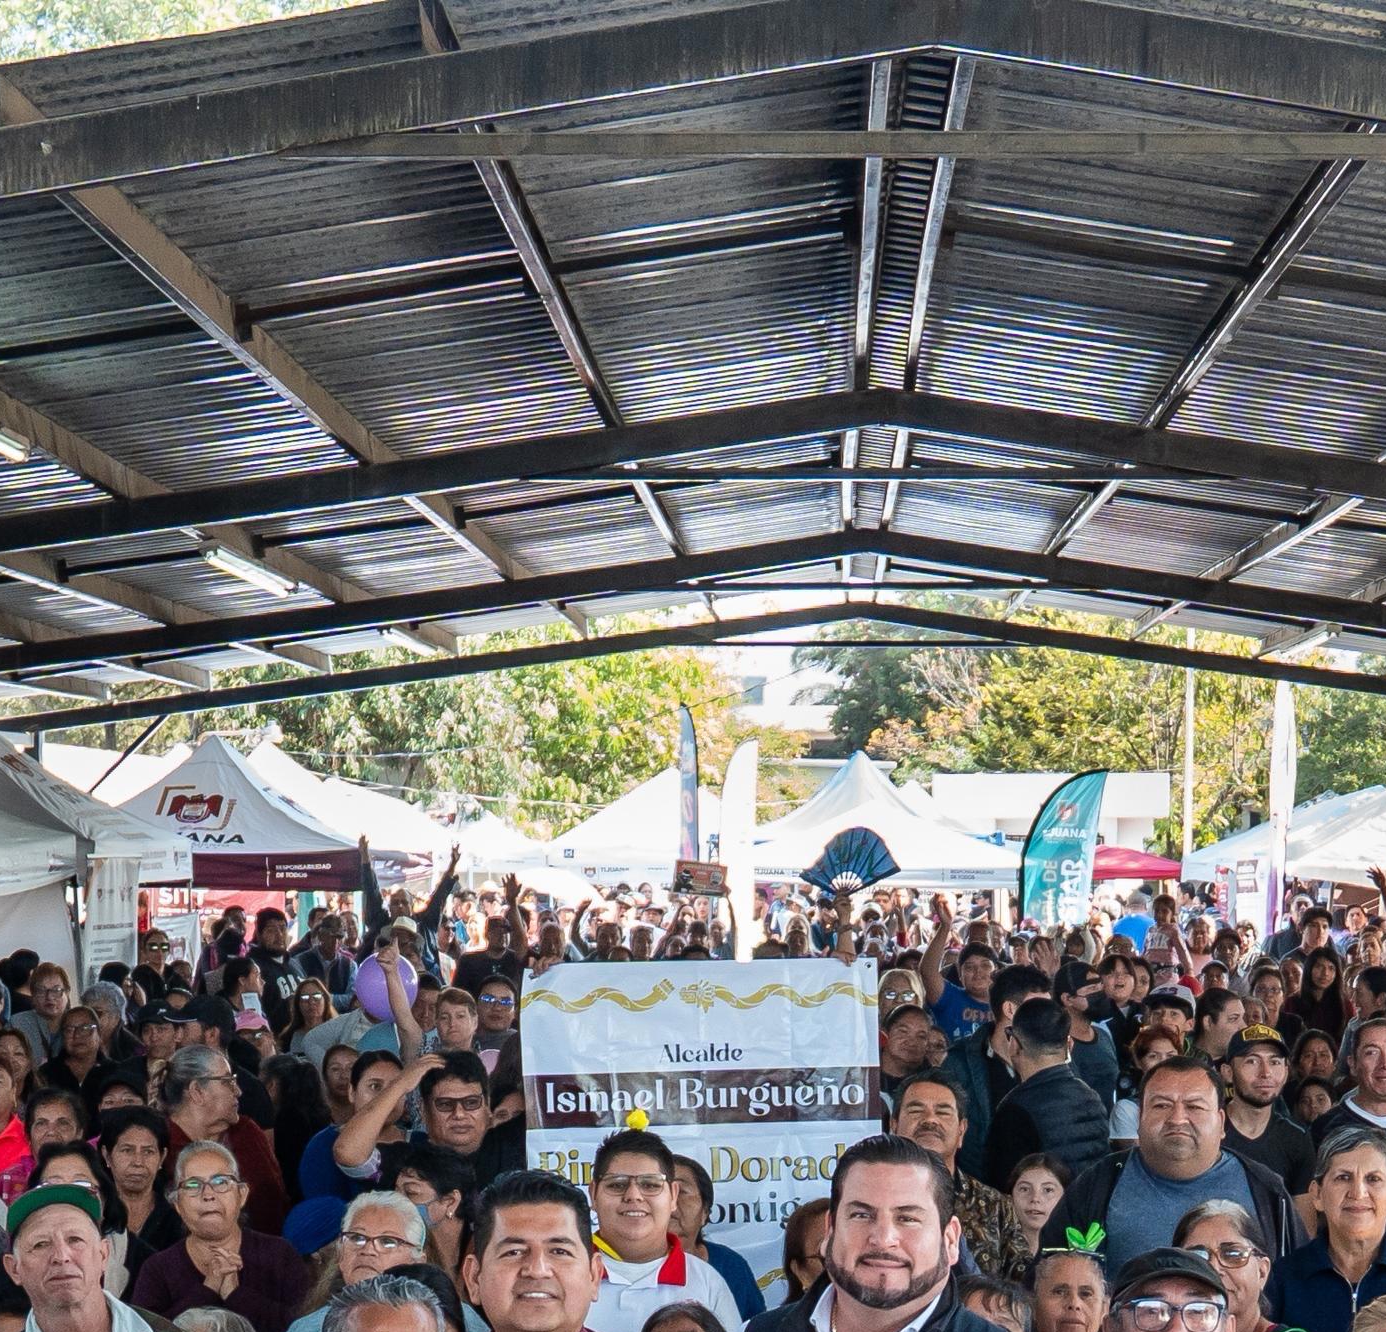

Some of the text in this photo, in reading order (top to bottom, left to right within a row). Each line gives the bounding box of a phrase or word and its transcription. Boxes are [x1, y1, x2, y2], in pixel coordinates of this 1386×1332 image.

[660, 1043, 743, 1063] Alcalde
[546, 1077, 864, 1116] Ismael Burgueño
[710, 1143, 851, 1182] Dorad
[706, 1192, 800, 1229] ontig
